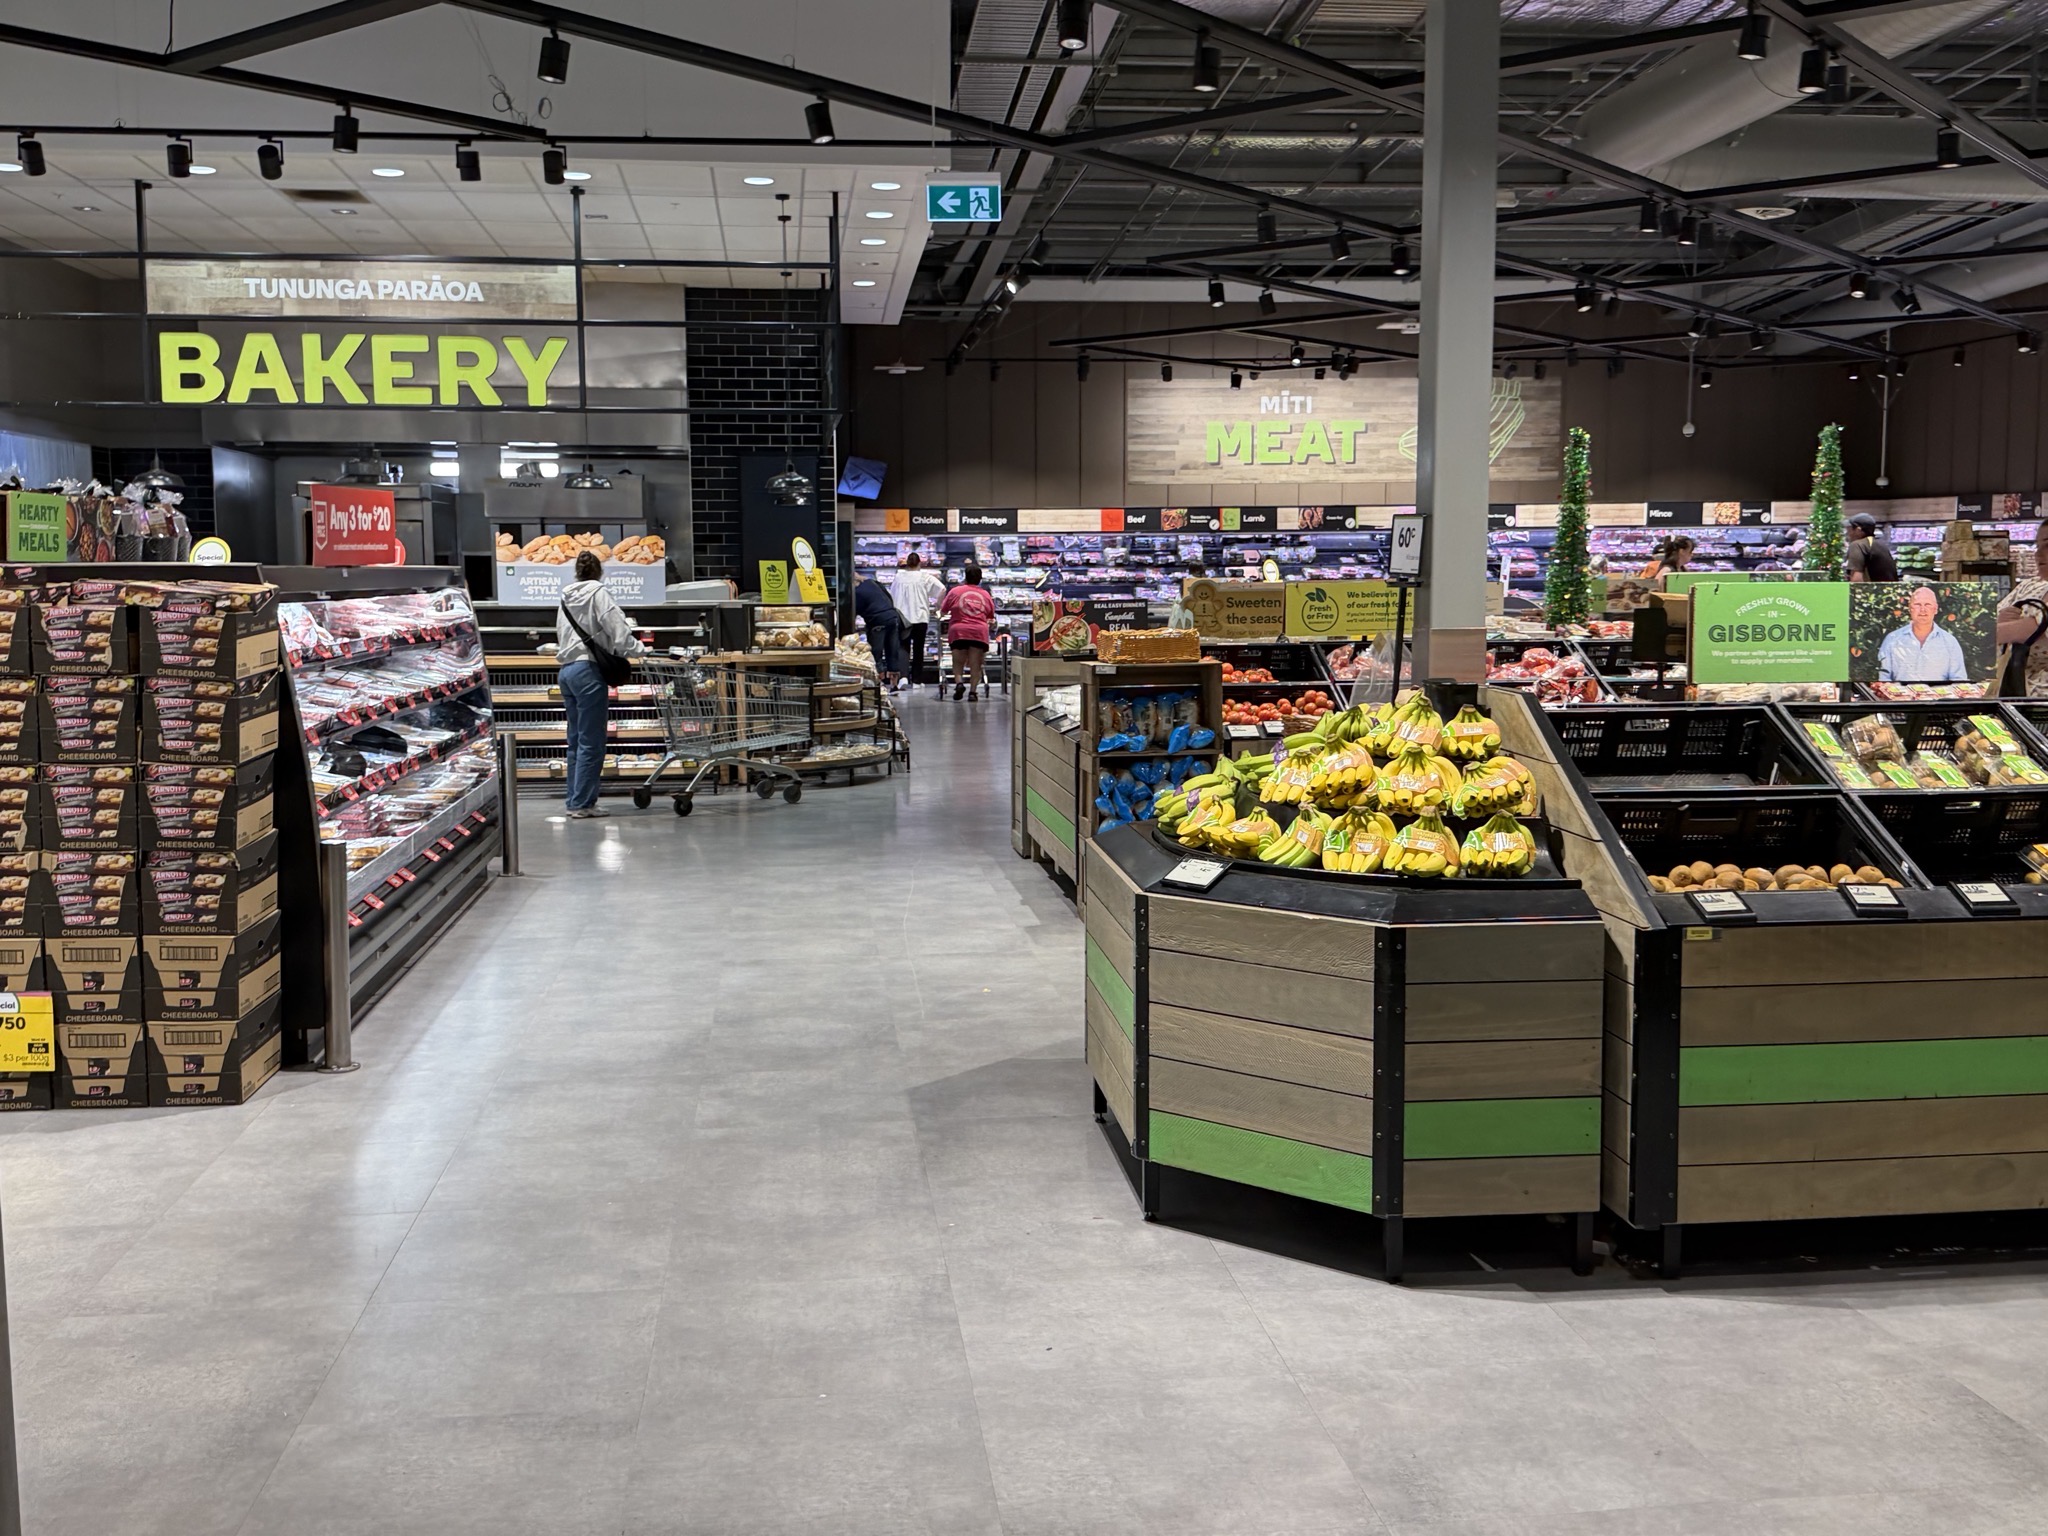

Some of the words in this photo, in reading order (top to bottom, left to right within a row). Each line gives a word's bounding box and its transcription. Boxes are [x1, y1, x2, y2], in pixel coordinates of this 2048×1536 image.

[244, 278, 374, 299] TUNUNGA
[378, 274, 484, 301] PARĀOA
[159, 332, 569, 406] BAKERY
[1206, 420, 1368, 465] MEAT
[19, 504, 59, 522] HEARTY
[1649, 510, 1673, 518] Mince
[330, 504, 348, 538] Any
[349, 505, 356, 531] 3
[357, 504, 372, 531] for
[373, 505, 391, 531] $20
[912, 516, 944, 525] Chicken
[962, 516, 1008, 526] Free-Range
[1127, 515, 1146, 523] Beef
[1243, 515, 1266, 523] Lamb
[19, 532, 59, 552] MEALS
[197, 554, 224, 563] Special
[520, 577, 561, 586] ARTISAN
[604, 577, 644, 586] ARTISAN
[1226, 597, 1281, 608] Sweeten
[1735, 597, 1774, 616] FRESHLY
[1776, 597, 1810, 616] GROWN
[1227, 613, 1248, 624] the
[1768, 610, 1778, 618] IN
[1708, 624, 1836, 643] GISBORNE
[157, 669, 216, 678] CHEESEBOARD
[58, 753, 117, 761] CHEESEBOARD
[160, 754, 219, 762] CHEESEBOARD
[60, 841, 118, 849] CHEESEBOARD
[157, 841, 216, 849] CHEESEBOARD
[66, 1015, 123, 1023] CHEESEBOARD
[4, 1053, 14, 1061] $3
[71, 1099, 129, 1107] CHEESEBOARD
[166, 1097, 223, 1105] CHEESEBOARD
